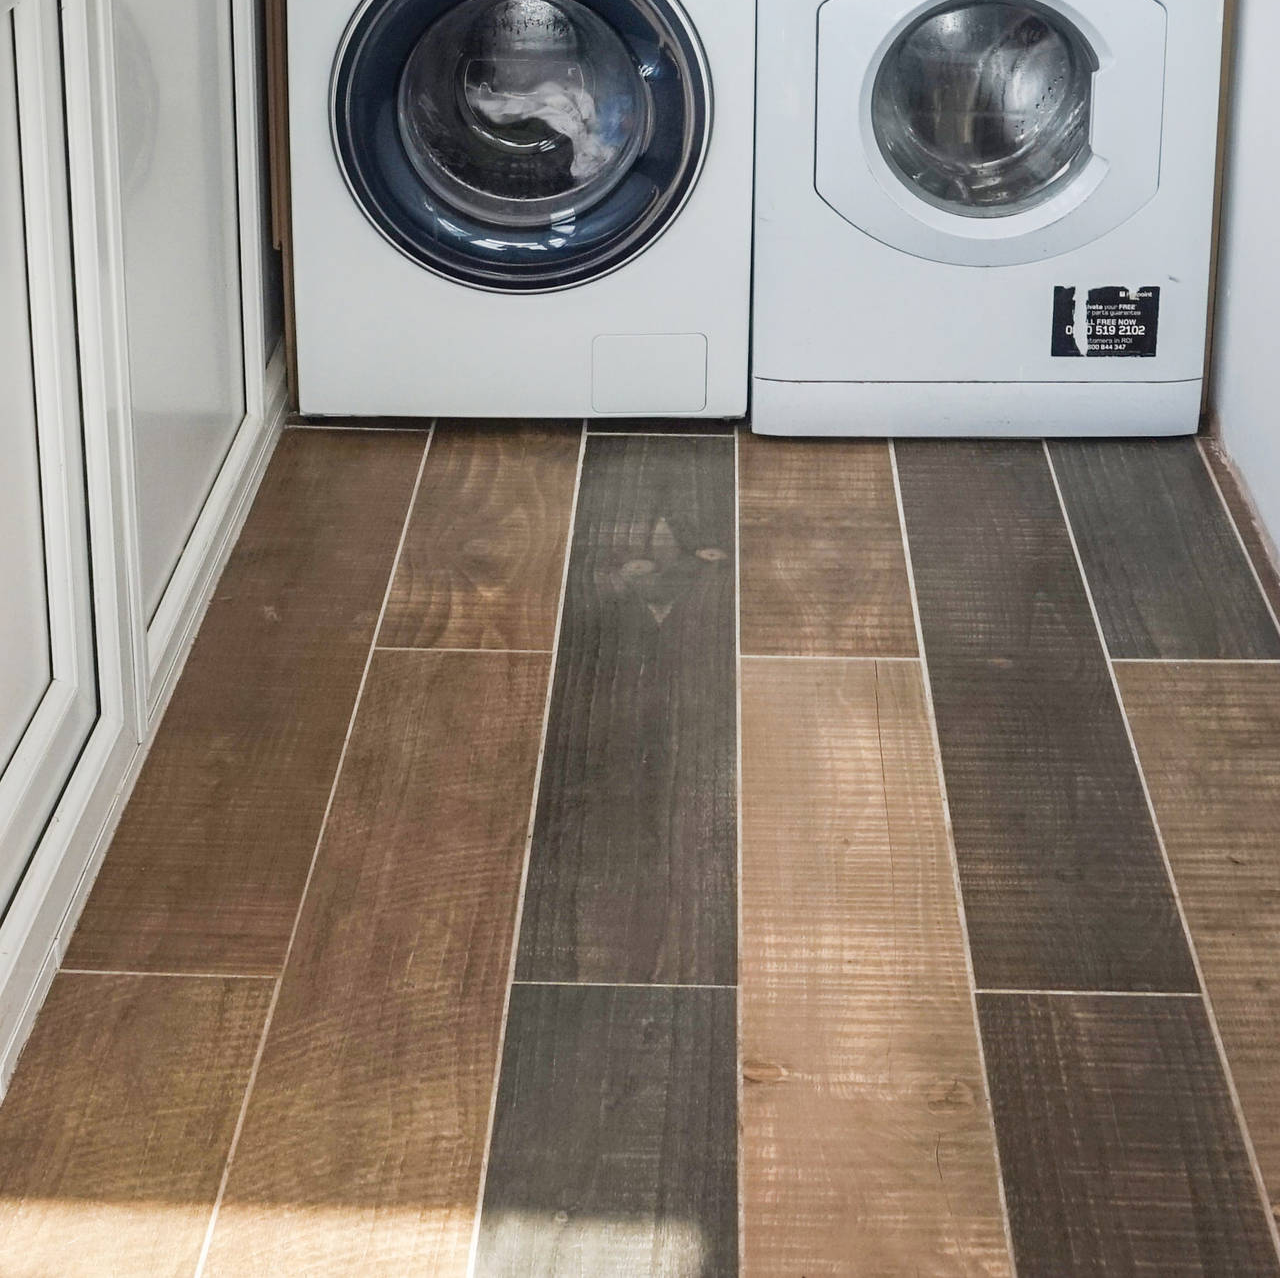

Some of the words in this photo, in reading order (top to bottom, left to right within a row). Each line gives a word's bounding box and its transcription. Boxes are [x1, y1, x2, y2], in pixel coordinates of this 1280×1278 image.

[1065, 325, 1093, 335] 00
[1095, 325, 1116, 335] 519
[1118, 325, 1146, 335] 2102
